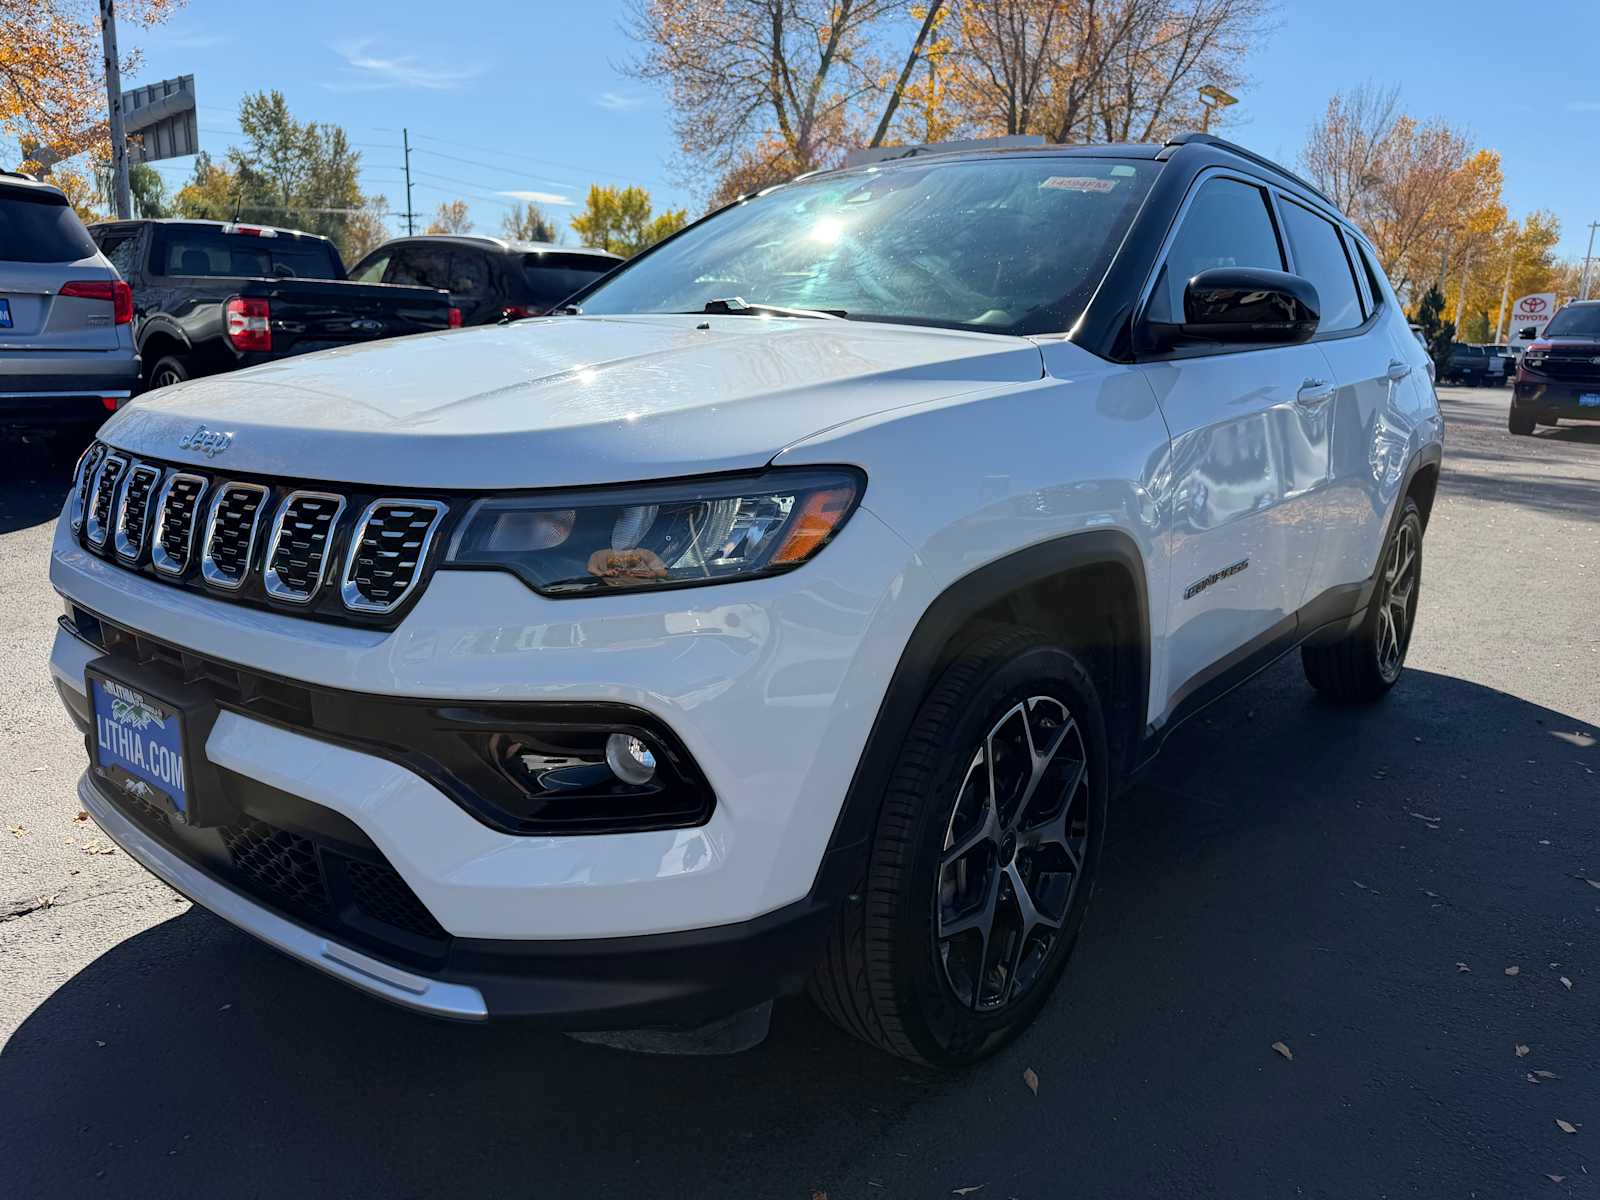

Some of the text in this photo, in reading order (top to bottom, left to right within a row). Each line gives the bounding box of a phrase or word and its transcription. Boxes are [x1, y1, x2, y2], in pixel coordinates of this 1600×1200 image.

[179, 424, 233, 459] Jeep
[1183, 558, 1249, 600] COMPASS
[97, 714, 185, 792] LITHIA.COM
